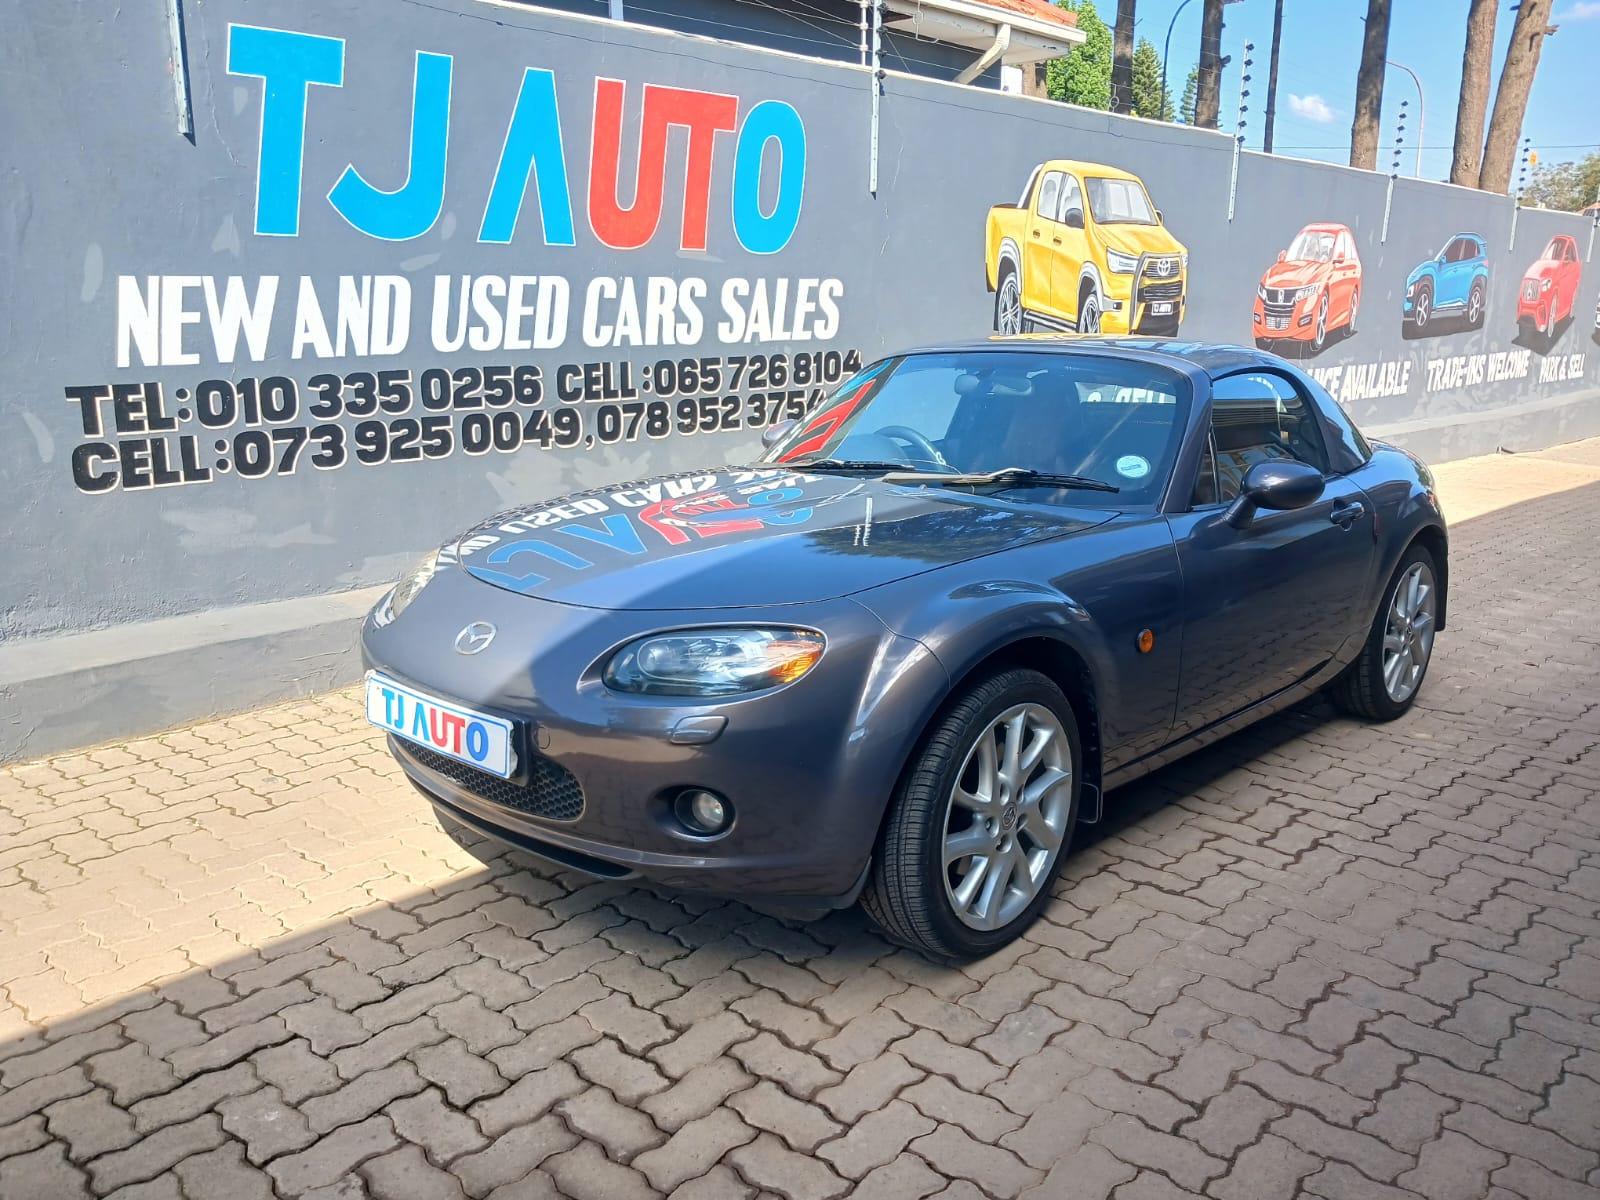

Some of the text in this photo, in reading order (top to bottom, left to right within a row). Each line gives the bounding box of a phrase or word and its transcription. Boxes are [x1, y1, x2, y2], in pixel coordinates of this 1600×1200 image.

[226, 22, 807, 255] TJ AUTO
[117, 274, 844, 368] NEW AND USED CARS SALES
[307, 370, 413, 421] 335
[420, 365, 544, 412] 0256
[727, 354, 789, 392] 726
[793, 350, 862, 386] 8104
[1340, 360, 1412, 404] AVAILABLE
[1427, 350, 1531, 392] TRADE-INS WELCOME
[1538, 356, 1561, 384] PARK
[1567, 353, 1586, 379] SELL
[354, 415, 455, 466] 925
[676, 396, 743, 436] 952
[382, 687, 489, 762] TJ AUTO
